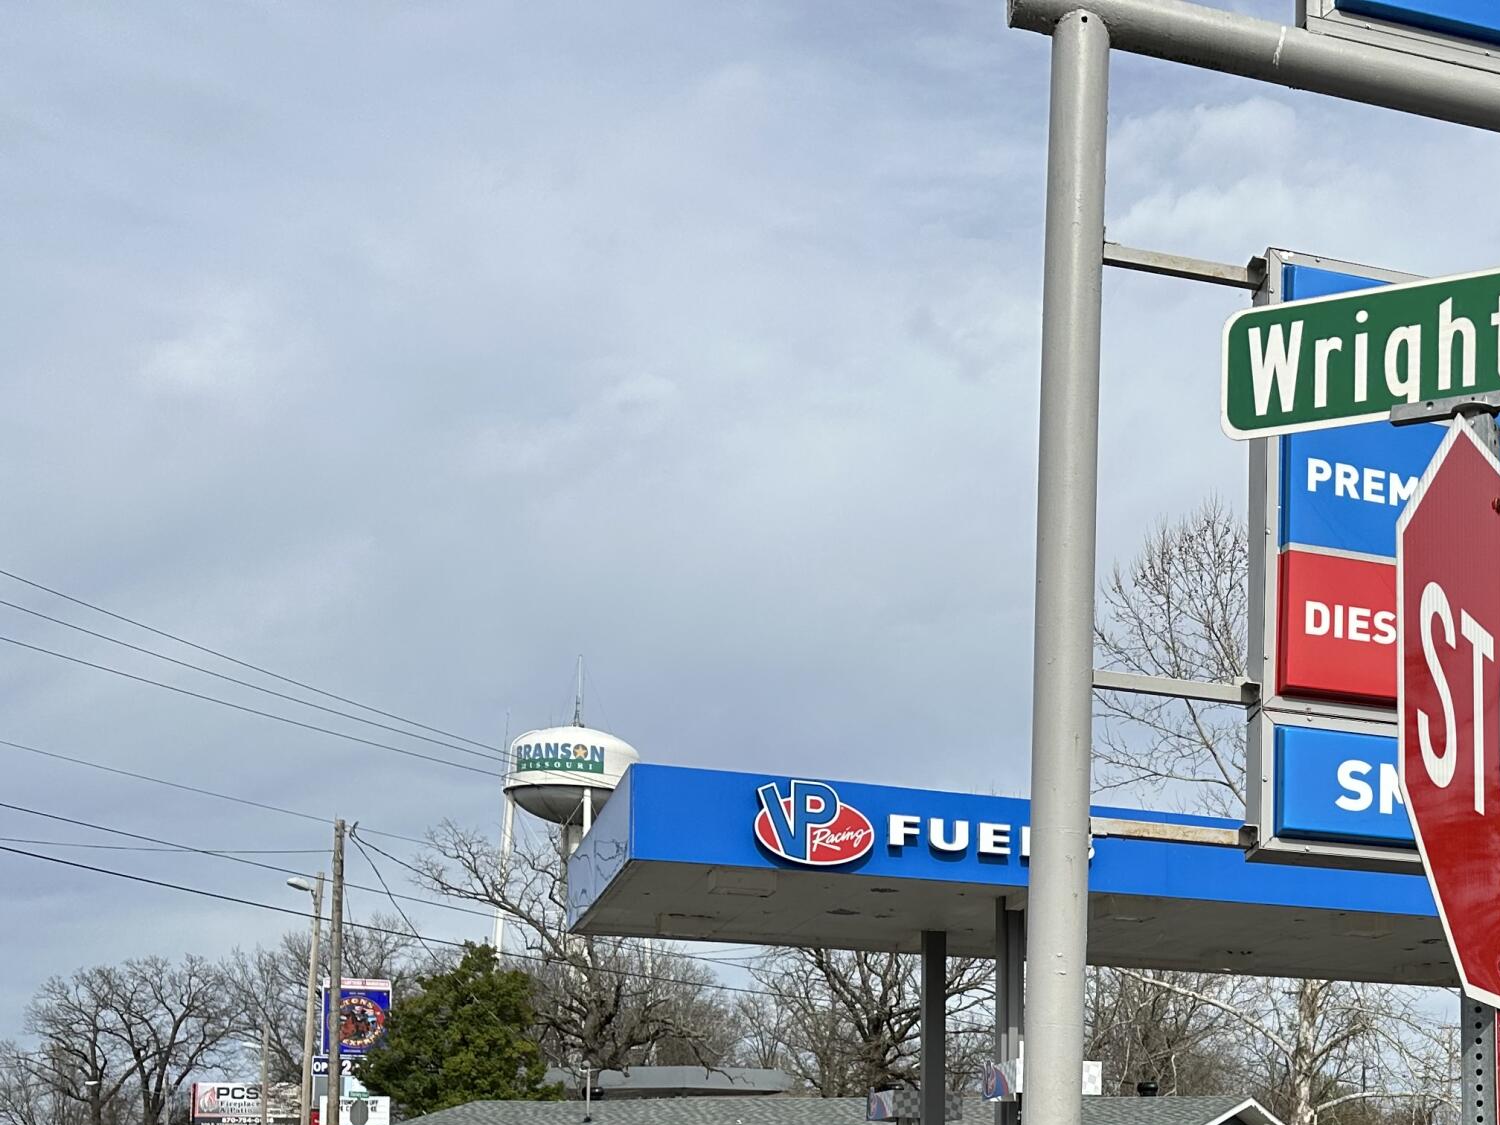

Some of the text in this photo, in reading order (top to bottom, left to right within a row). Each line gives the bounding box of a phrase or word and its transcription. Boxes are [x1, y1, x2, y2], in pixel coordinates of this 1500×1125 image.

[516, 743, 604, 763] BRANSON
[521, 761, 593, 770] MISSOURI
[757, 780, 841, 861] VP
[812, 826, 872, 851] Racing
[888, 814, 1094, 860] FUE
[216, 1087, 259, 1100] PCS
[220, 1100, 261, 1108] Fireplace
